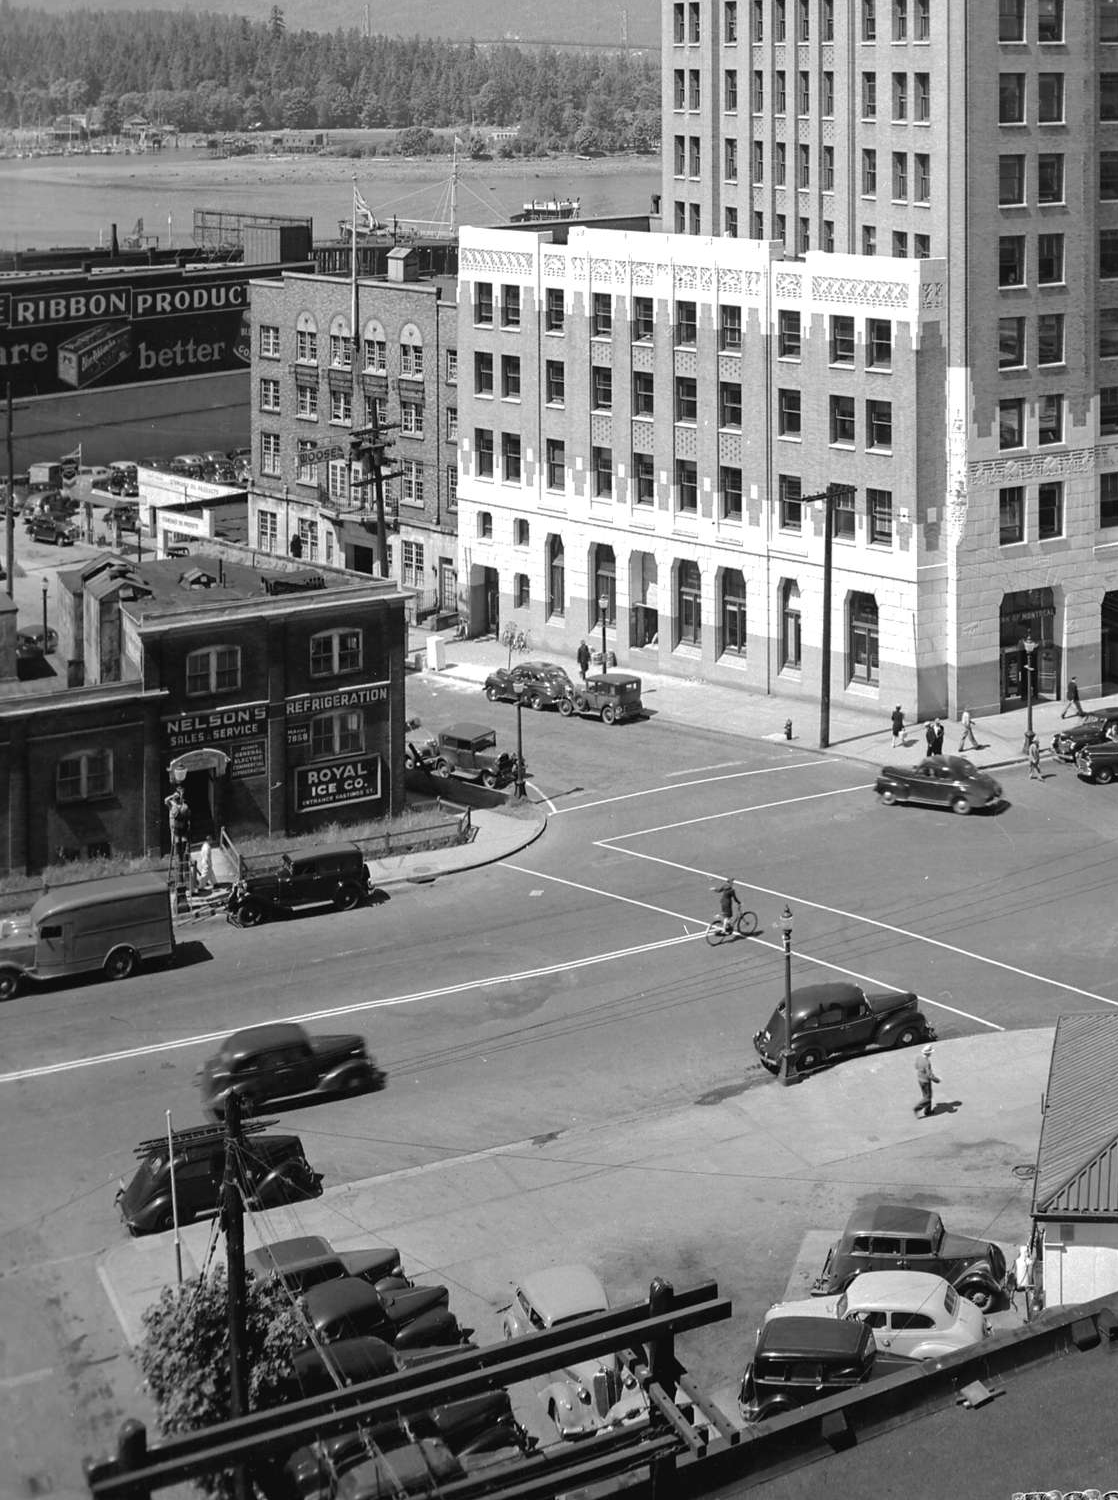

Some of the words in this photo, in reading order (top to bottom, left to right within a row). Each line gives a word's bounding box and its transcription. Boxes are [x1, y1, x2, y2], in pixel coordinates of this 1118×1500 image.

[17, 293, 126, 323] RIBBON
[138, 337, 225, 370] better
[286, 687, 387, 714] REFRIGERATION
[167, 707, 267, 733] NELSON'S
[170, 732, 205, 747] SALES
[213, 723, 258, 740] SERVICE
[307, 763, 368, 784] ROYAL
[311, 782, 337, 797] ICE
[343, 778, 368, 790] CO.
